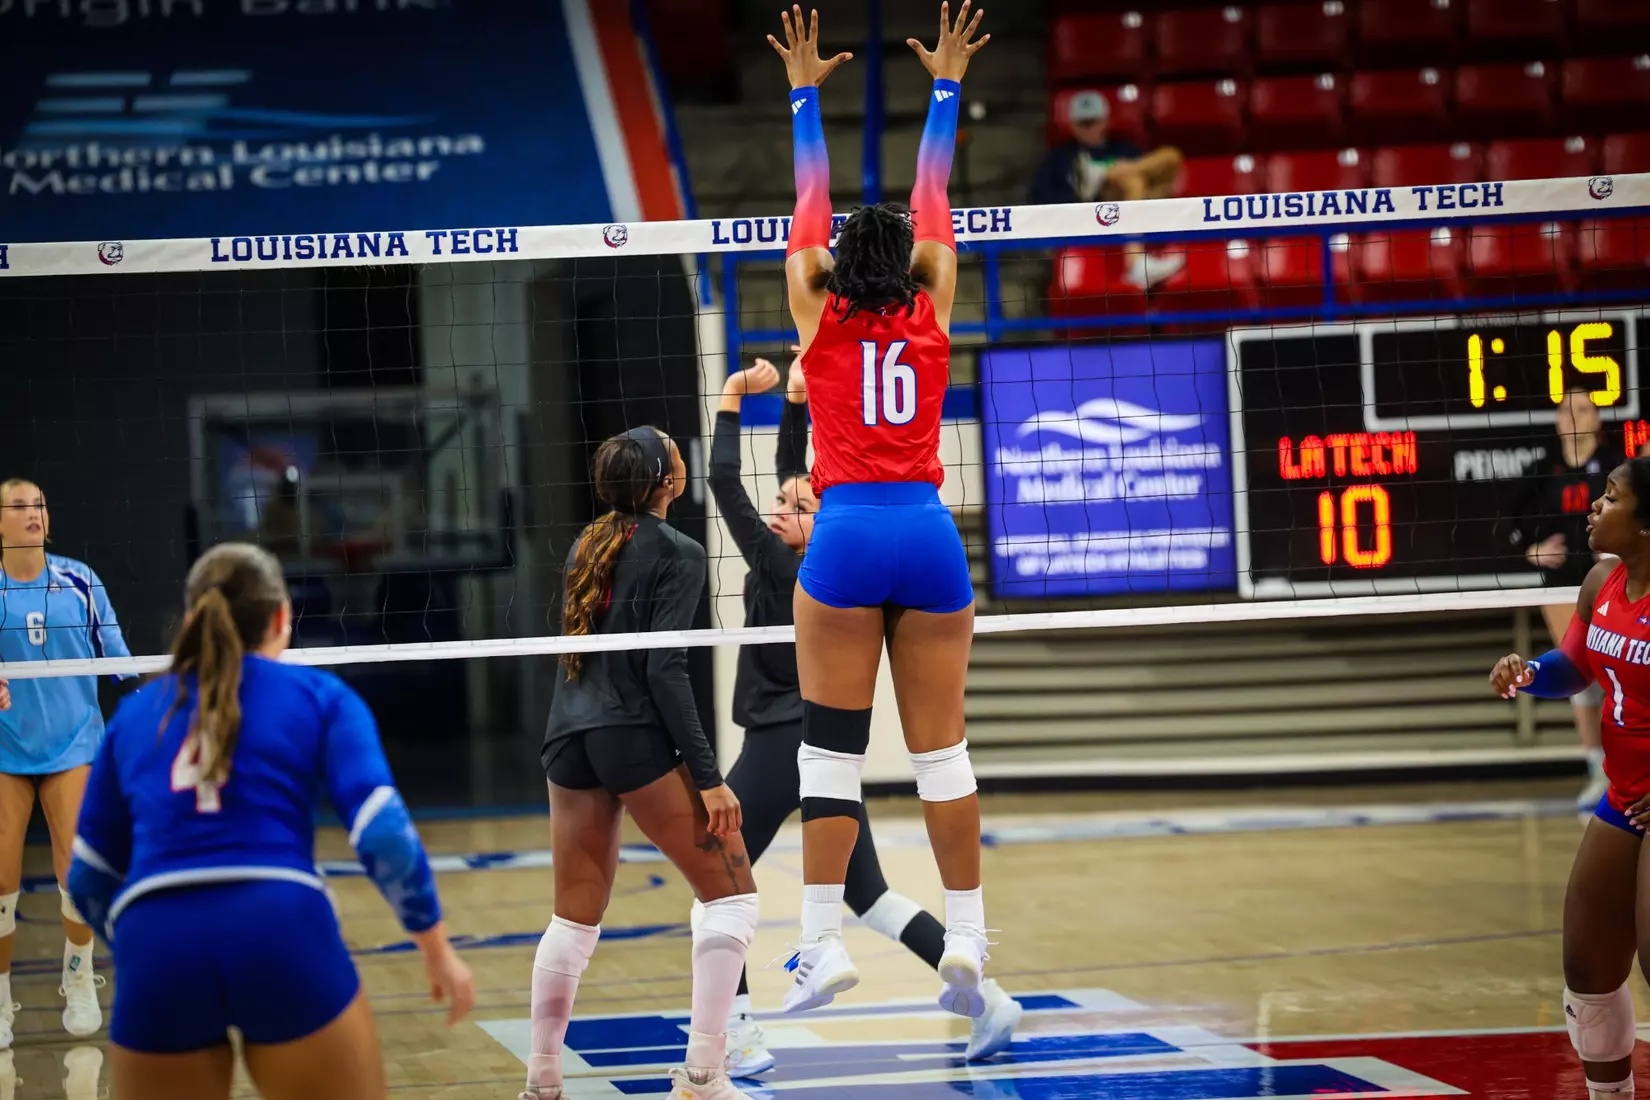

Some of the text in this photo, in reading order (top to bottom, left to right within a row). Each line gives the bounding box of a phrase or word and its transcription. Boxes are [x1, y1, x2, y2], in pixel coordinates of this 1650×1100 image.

[2, 132, 485, 169] orthern Louisiana
[8, 159, 441, 196] Medical Center
[950, 208, 1012, 234] ECH
[1203, 182, 1504, 222] LOUISIANA TECH
[211, 228, 519, 262] LOUISIANA TECH
[859, 340, 917, 426] 16
[1318, 484, 1392, 568] 10
[25, 610, 47, 646] 6
[1604, 667, 1625, 727] 1
[170, 728, 230, 813] 4
